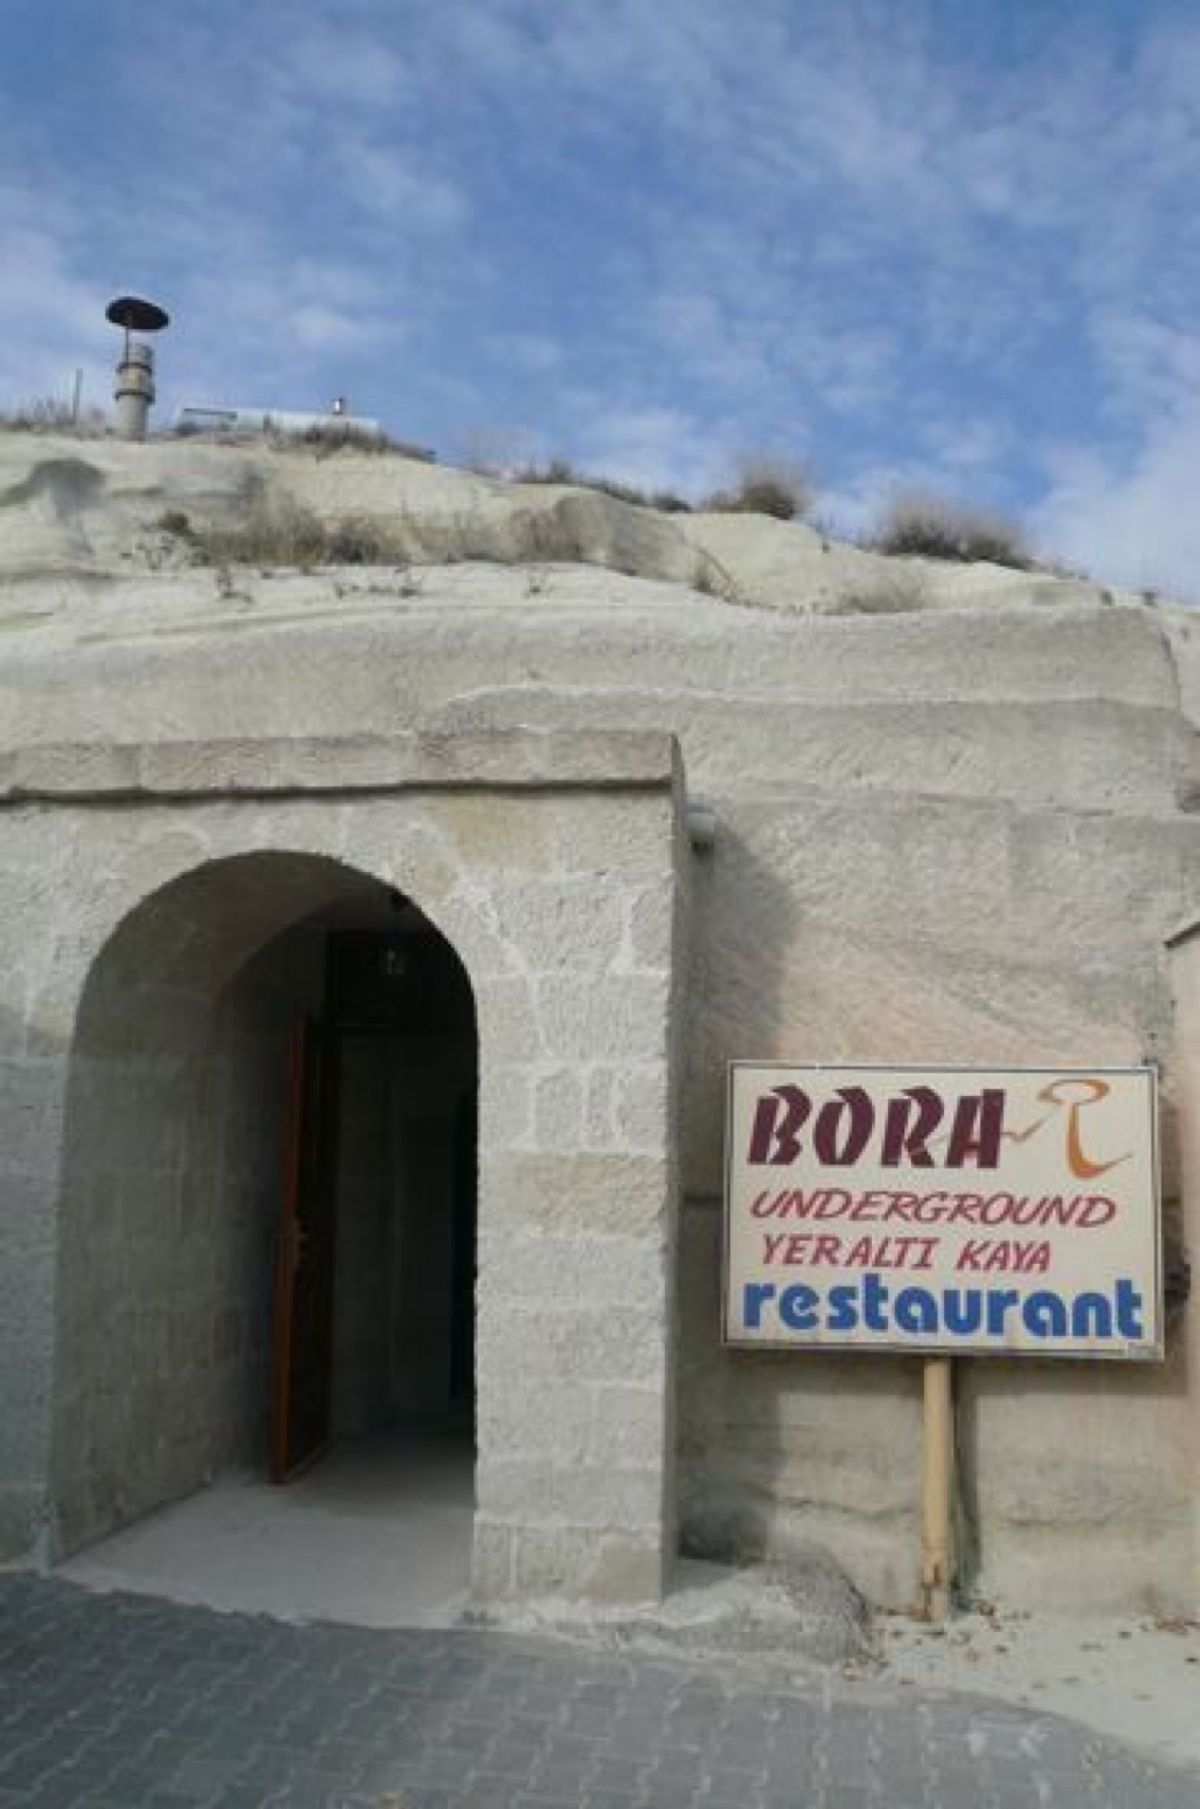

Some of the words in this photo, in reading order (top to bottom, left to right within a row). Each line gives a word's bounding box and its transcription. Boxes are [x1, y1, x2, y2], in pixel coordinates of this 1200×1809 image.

[747, 1083, 1005, 1168] BORA
[751, 1188, 1116, 1228] UNDERGROUND
[955, 1240, 1051, 1272] KAYA
[743, 1273, 1142, 1339] restaurant
